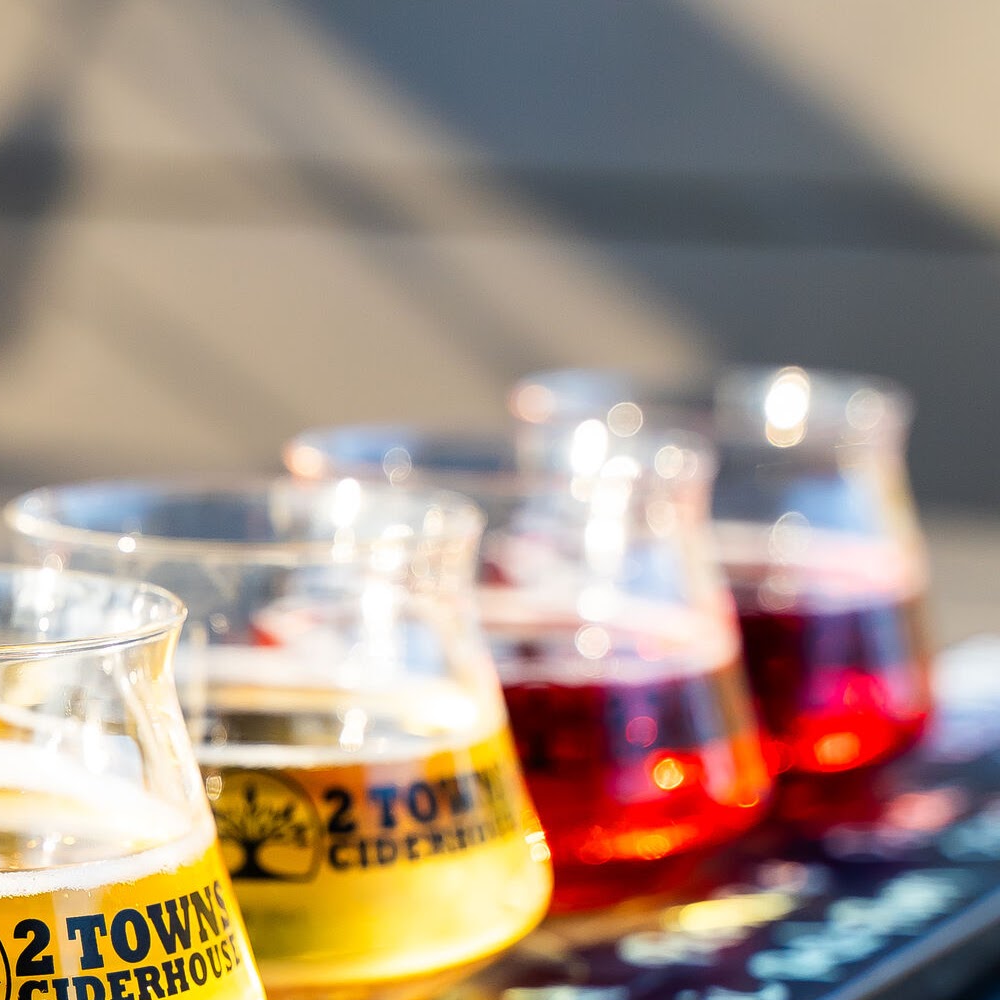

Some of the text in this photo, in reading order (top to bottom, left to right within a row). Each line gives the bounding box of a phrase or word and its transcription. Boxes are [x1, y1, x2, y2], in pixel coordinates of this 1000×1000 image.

[323, 788, 356, 833] 2
[13, 880, 231, 977] 2 TOWNS
